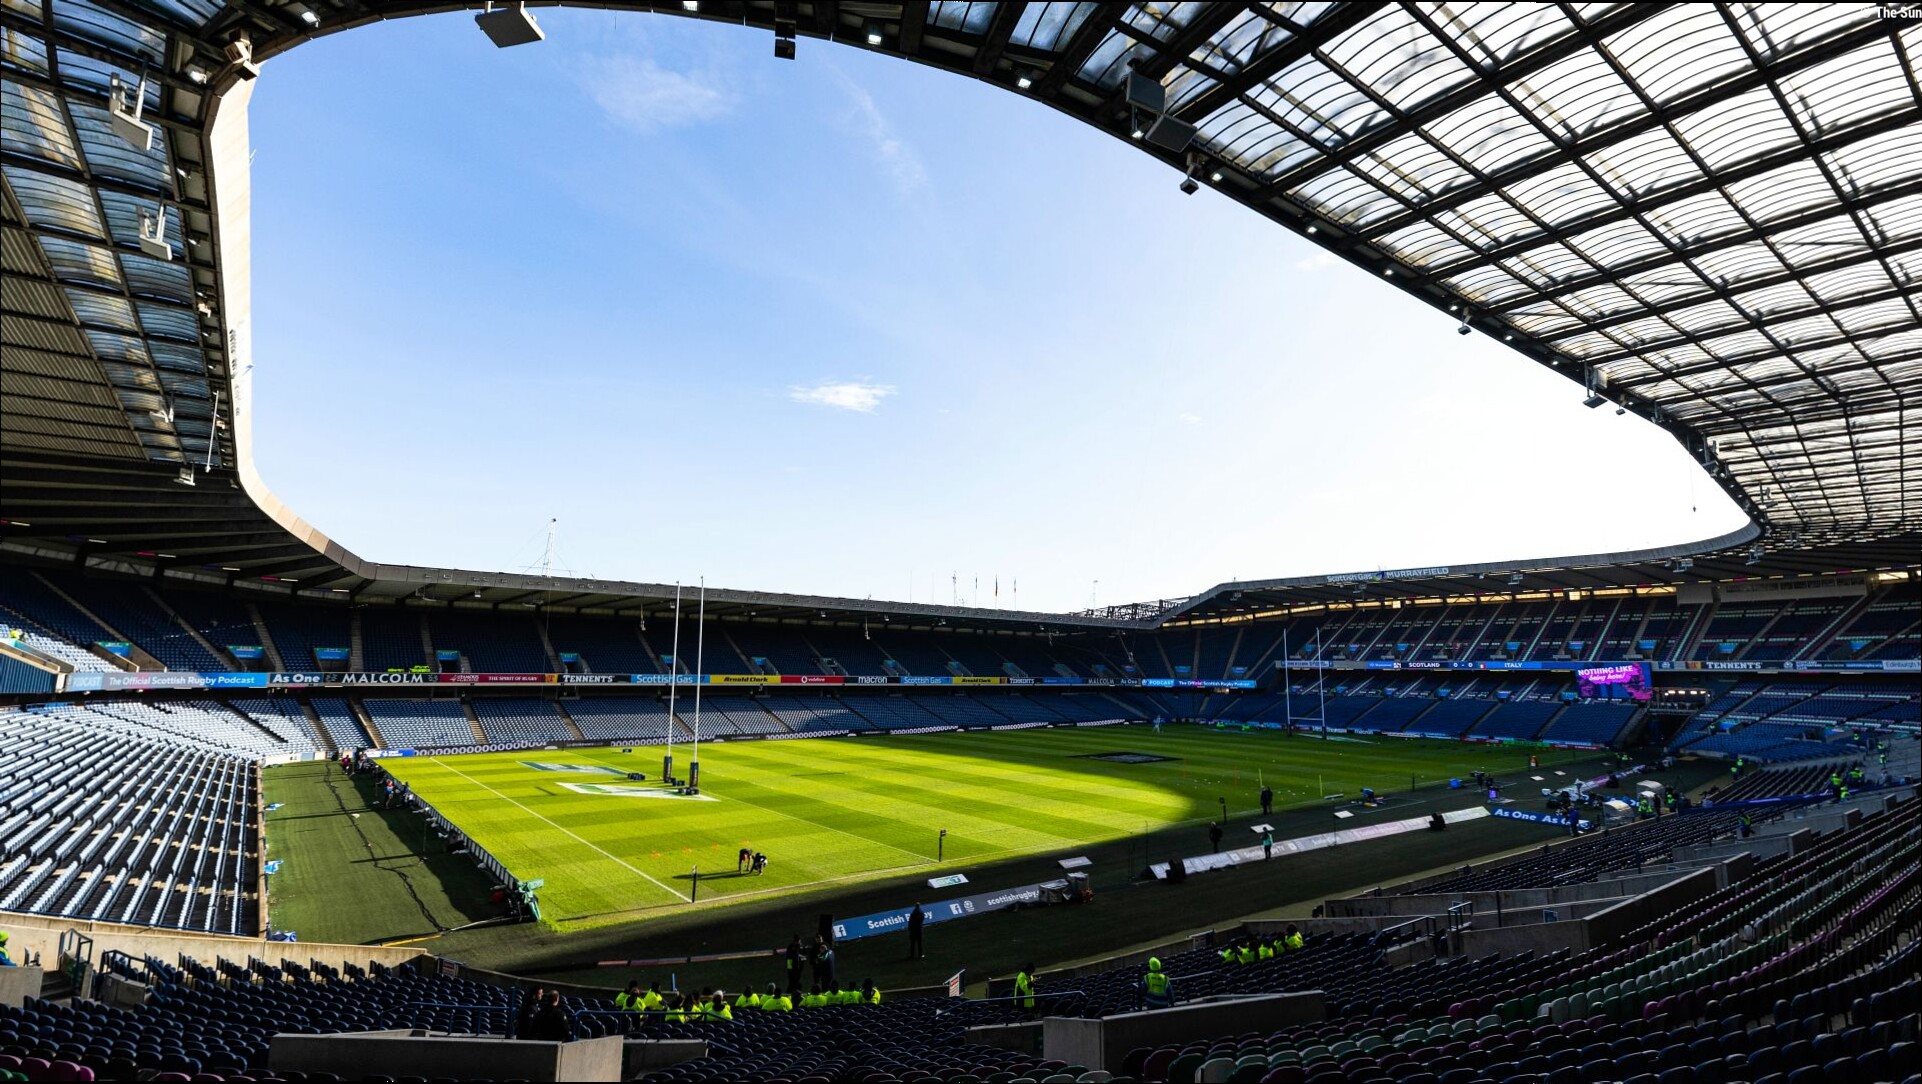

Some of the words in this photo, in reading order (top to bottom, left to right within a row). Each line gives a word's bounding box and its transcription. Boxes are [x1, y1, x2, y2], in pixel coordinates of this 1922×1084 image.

[1386, 567, 1450, 579] MURRAYFIELD
[1615, 665, 1634, 674] LIKE
[109, 677, 121, 686] The
[122, 676, 150, 686] Official
[151, 676, 186, 685] Scottish
[187, 676, 217, 686] Rugby
[218, 676, 255, 685] Podcast
[272, 674, 295, 683] As
[297, 674, 320, 683] One
[341, 673, 424, 684] MALCOLM
[563, 675, 614, 683] TENNENT'S
[677, 675, 693, 683] Gas
[858, 676, 887, 684] macron
[1494, 809, 1510, 817] As
[1512, 811, 1537, 821] One
[1542, 815, 1558, 824] As
[867, 915, 904, 929] Scottish
